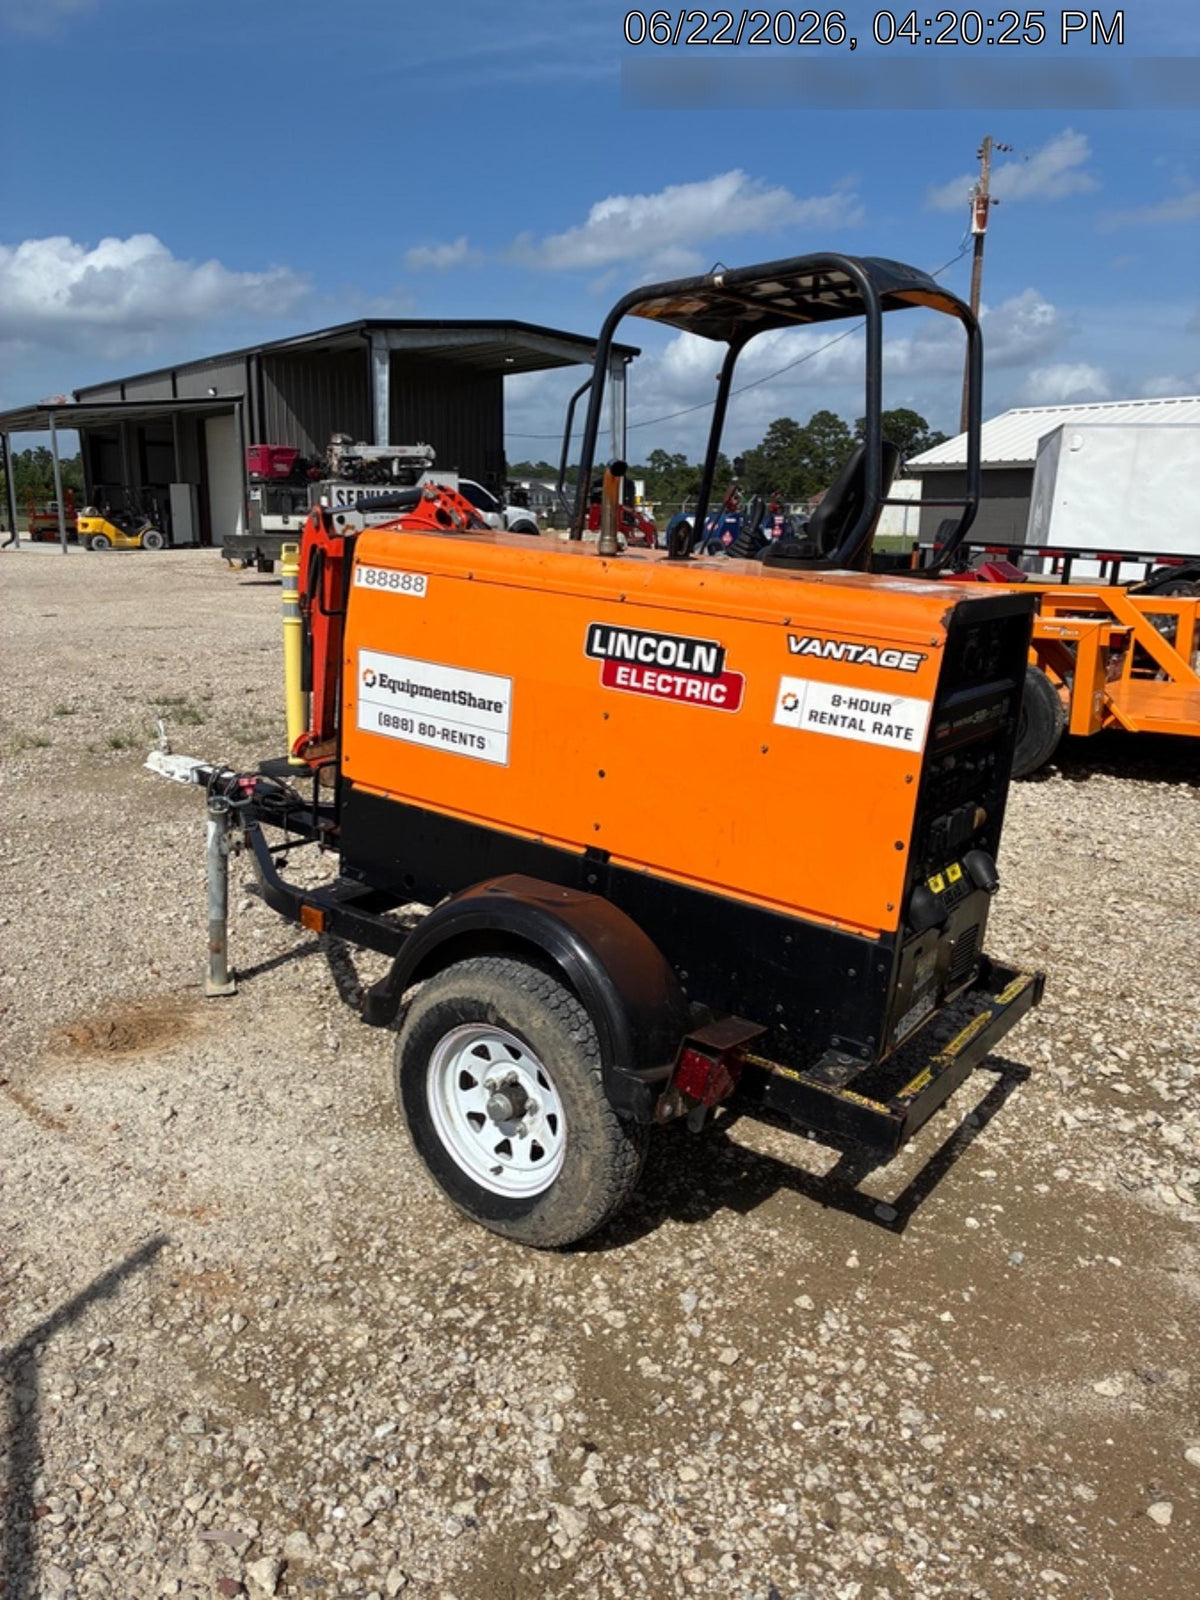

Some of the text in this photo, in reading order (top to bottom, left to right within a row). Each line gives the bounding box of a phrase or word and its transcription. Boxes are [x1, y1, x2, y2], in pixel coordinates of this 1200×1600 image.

[356, 568, 425, 593] 188888
[592, 629, 718, 674] LINCOLN
[787, 634, 922, 673] VANTAGE
[378, 673, 504, 714] EquipmentShare
[615, 666, 728, 704] ELECTRIC
[831, 694, 893, 717] 8-HOUR
[378, 711, 487, 751] (888) 80-RENTS
[808, 709, 867, 732] RENTAL
[872, 721, 915, 742] RATE
